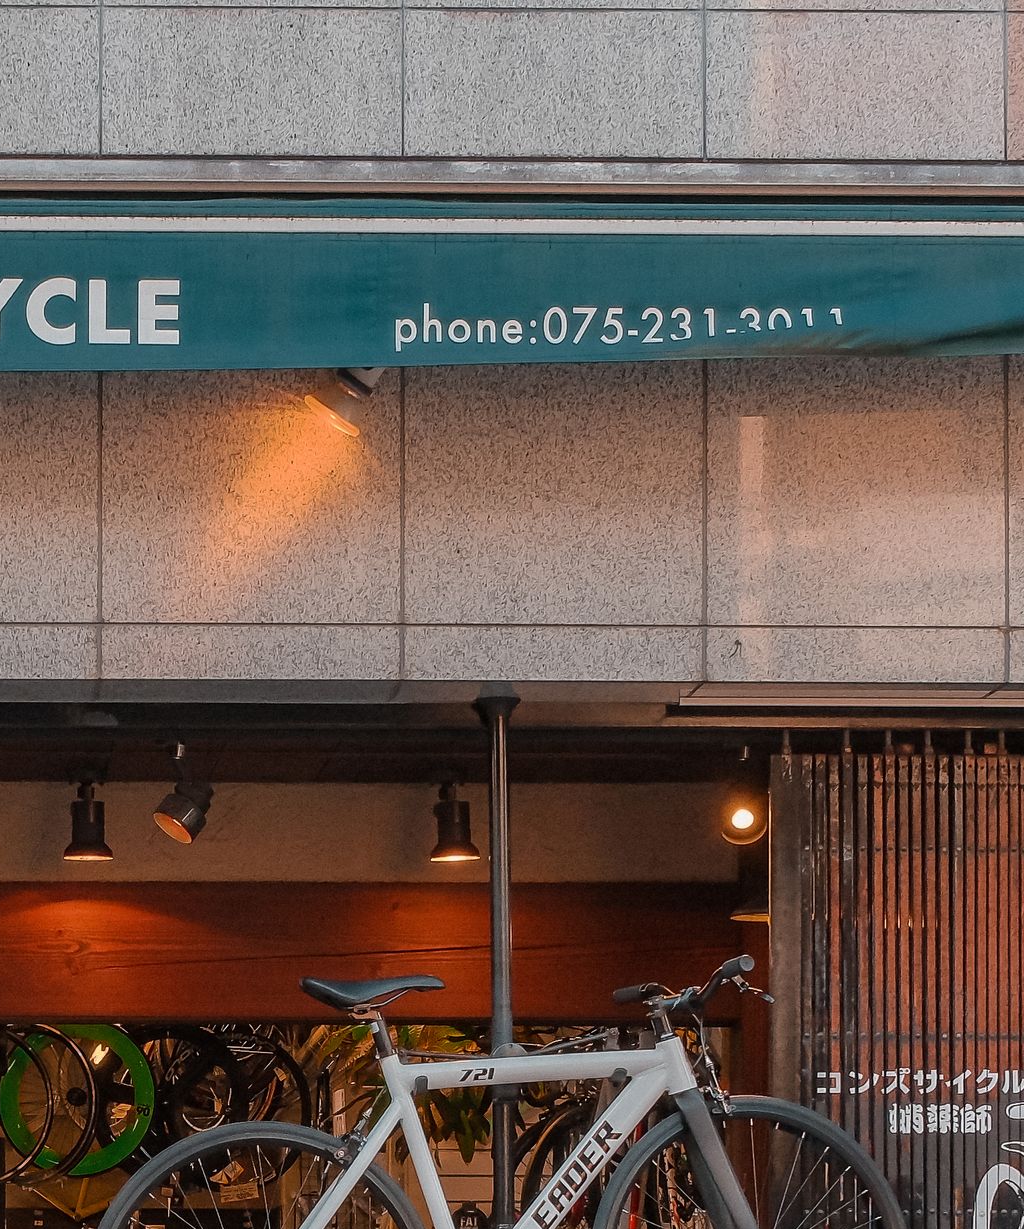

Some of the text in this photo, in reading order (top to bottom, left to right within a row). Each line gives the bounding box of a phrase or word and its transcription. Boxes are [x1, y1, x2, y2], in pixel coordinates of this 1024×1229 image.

[458, 1067, 495, 1082] 721
[816, 1067, 1024, 1095] コンズサイクル
